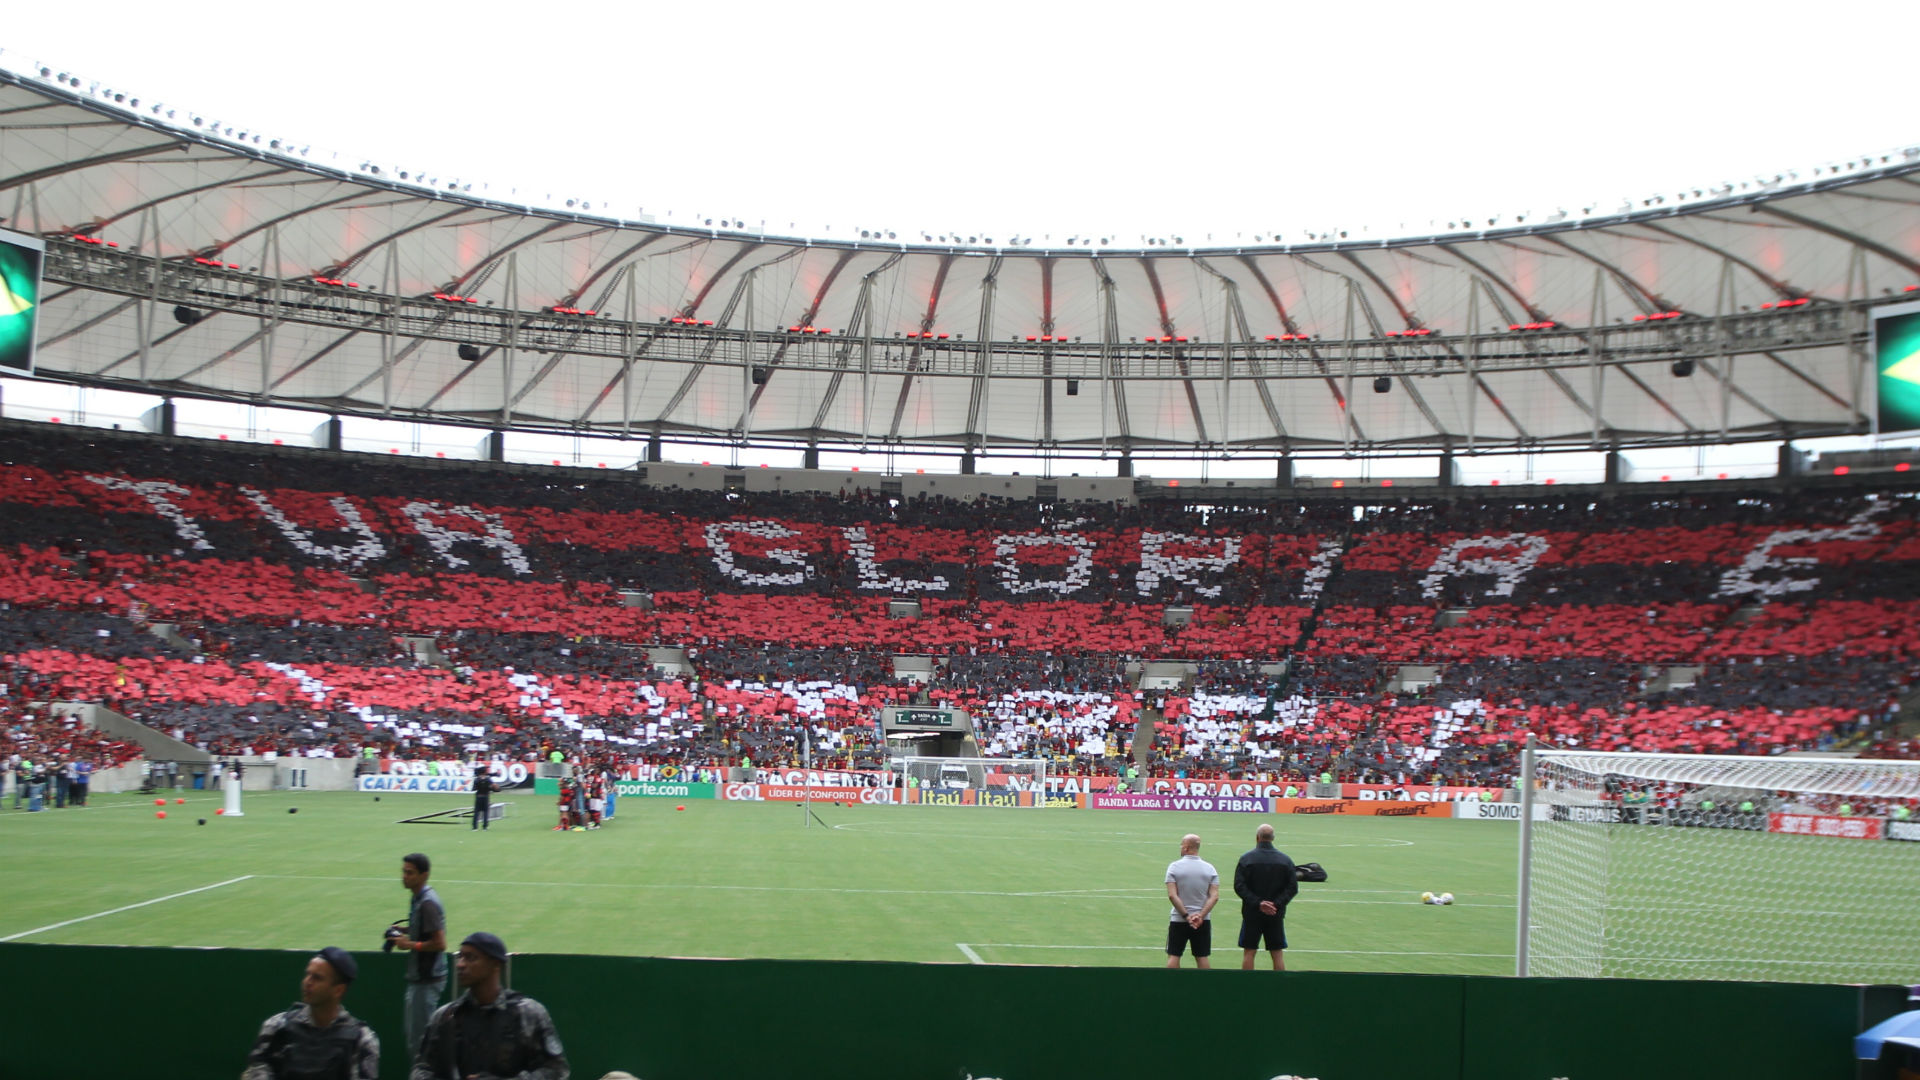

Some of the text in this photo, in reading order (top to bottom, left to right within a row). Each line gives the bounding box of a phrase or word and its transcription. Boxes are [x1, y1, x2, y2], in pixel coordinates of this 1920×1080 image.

[84, 473, 532, 575] TUA
[363, 777, 474, 791] CAIXA CAIX
[726, 785, 898, 804] GOL LÍDER EM CONFORTO GOL
[922, 790, 960, 805] Itaú
[978, 791, 1017, 806] Itaú
[1098, 798, 1128, 807] BANDA
[1132, 799, 1161, 808] LARGA
[1173, 799, 1214, 810] VIVO
[1218, 800, 1263, 811] FIBRA
